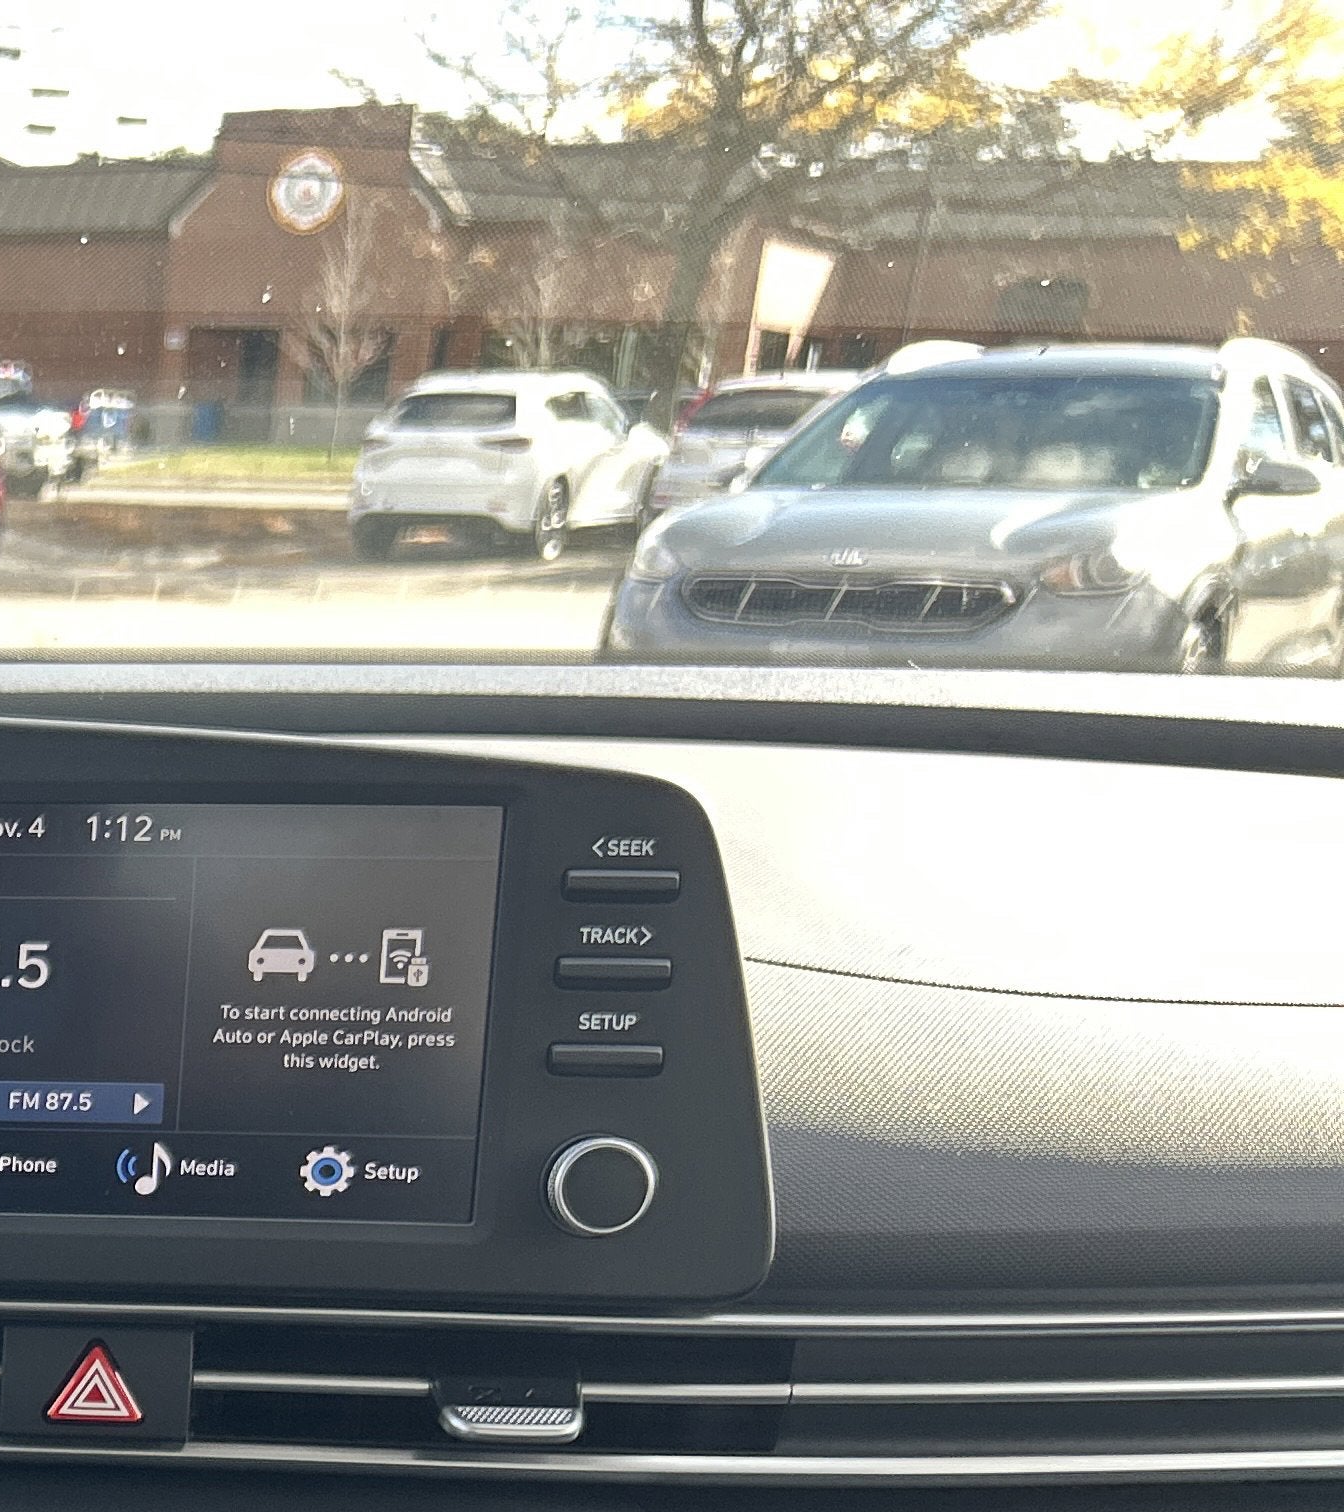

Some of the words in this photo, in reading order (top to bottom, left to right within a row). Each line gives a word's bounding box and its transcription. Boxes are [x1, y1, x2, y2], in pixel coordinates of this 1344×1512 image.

[28, 816, 46, 838] 4
[86, 815, 153, 842] 1:12
[159, 828, 182, 841] PM
[220, 1004, 241, 1020] To
[244, 1005, 286, 1021] start
[289, 1006, 381, 1026] connecting
[385, 1006, 453, 1023] Android
[578, 1013, 637, 1031] SETUP
[212, 1028, 253, 1044] Auto
[256, 1031, 276, 1044] or
[279, 1029, 329, 1048] Apple
[332, 1029, 403, 1050] CarPlay,
[407, 1034, 456, 1050] press
[283, 1052, 315, 1069] this
[318, 1053, 380, 1073] widget.
[9, 1091, 41, 1110] FM
[45, 1092, 92, 1112] 87.5
[0, 1155, 57, 1173] Phone
[180, 1159, 235, 1177] Media
[364, 1162, 419, 1184] Setup
